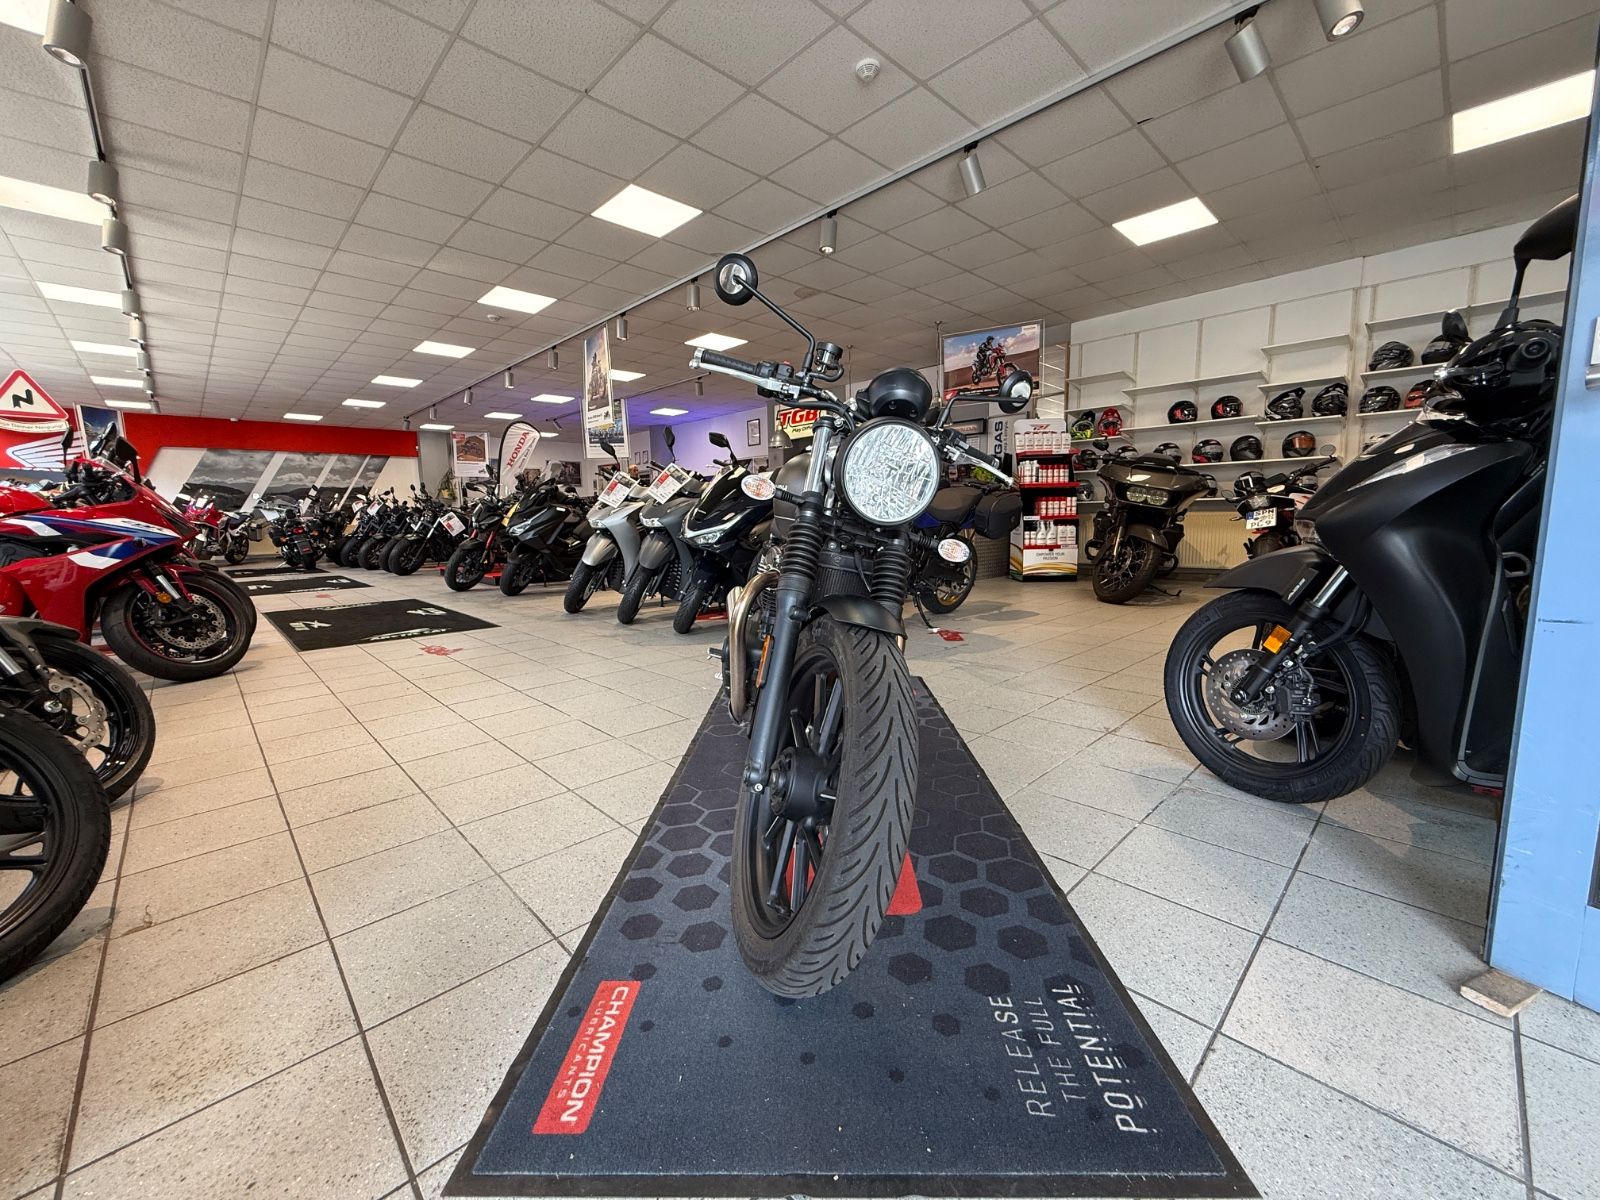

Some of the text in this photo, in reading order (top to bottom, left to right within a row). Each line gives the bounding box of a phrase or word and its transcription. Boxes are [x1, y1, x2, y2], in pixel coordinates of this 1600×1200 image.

[507, 431, 530, 468] HONDA
[779, 408, 818, 427] TGB
[994, 421, 1004, 456] GAS
[557, 1000, 605, 1099] LUBRICANTS
[560, 986, 629, 1122] CHAMPION
[989, 996, 1056, 1117] RELEASE
[1023, 996, 1086, 1103] THE FULL
[1051, 983, 1149, 1134] POTENTIAL
